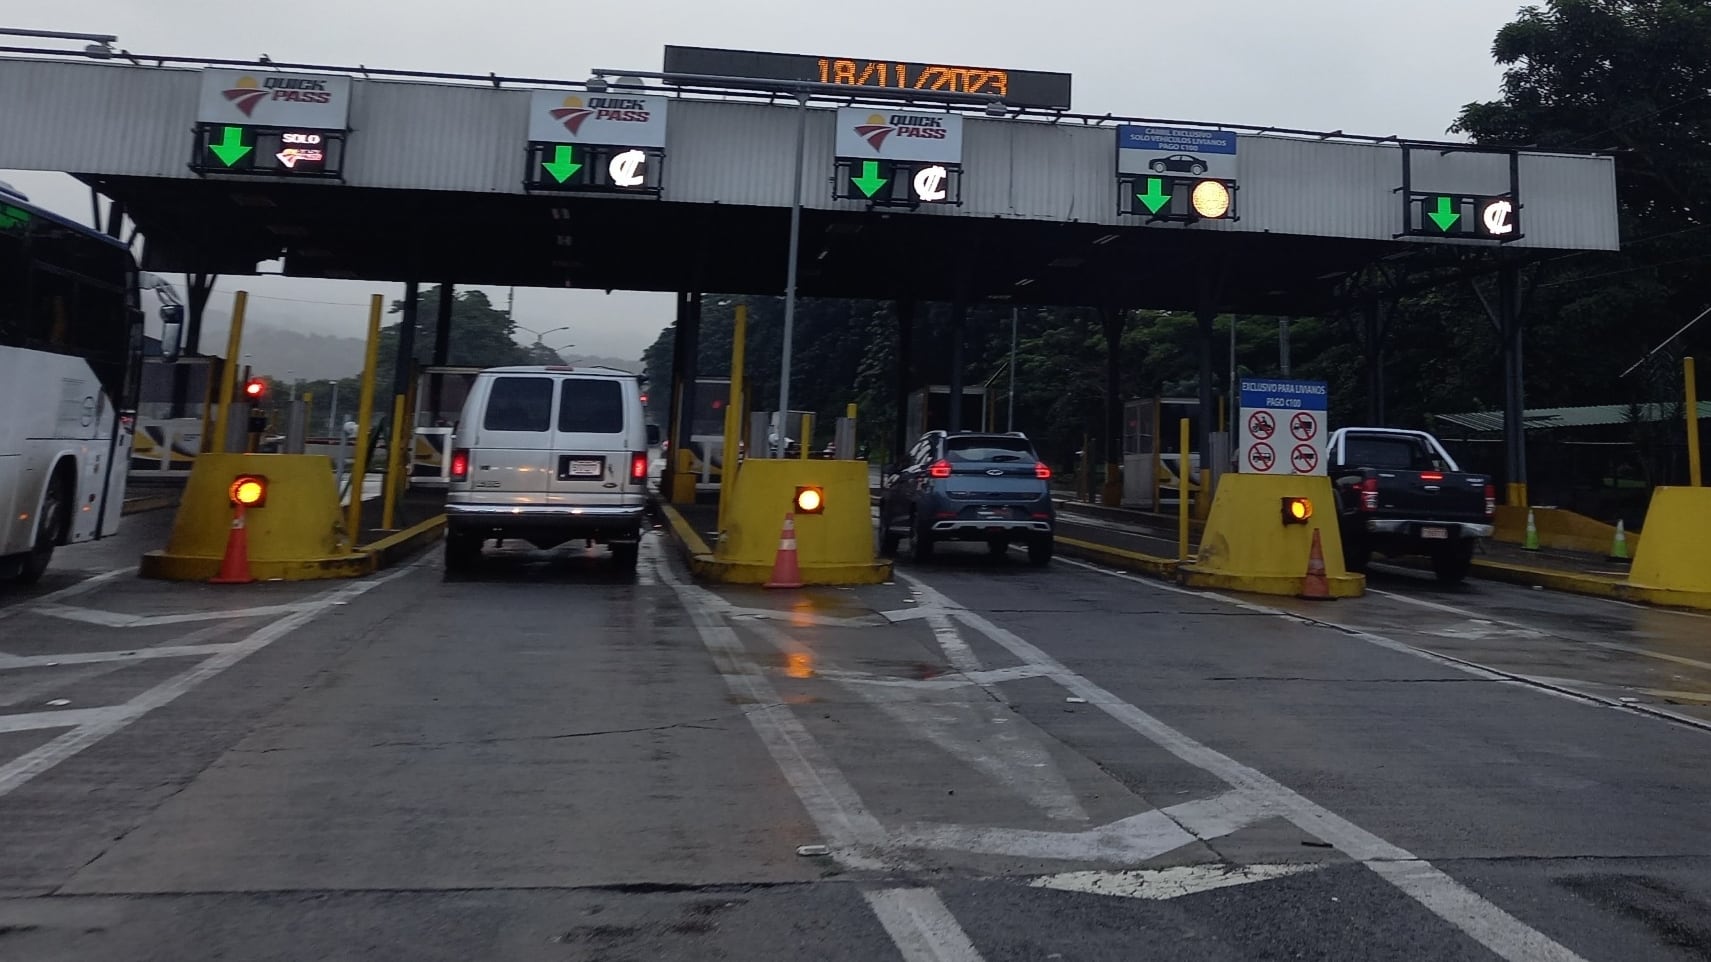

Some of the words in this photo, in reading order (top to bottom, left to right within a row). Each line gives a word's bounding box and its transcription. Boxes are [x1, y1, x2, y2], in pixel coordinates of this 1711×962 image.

[263, 77, 327, 91] QUICK
[818, 58, 1007, 97] 18/11/2023
[272, 90, 331, 104] PASS
[588, 97, 646, 110] QUICK
[595, 109, 650, 122] PASS
[889, 114, 943, 127] QUICK
[282, 133, 321, 144] SOLO
[896, 126, 947, 139] PASS
[1173, 129, 1213, 139] EXCLUSIVO
[1130, 133, 1150, 141] SOLO
[1192, 138, 1227, 147] LIVIANOS
[1158, 142, 1180, 150] PAGO
[1242, 382, 1278, 393] EXCLUSIVO
[1278, 383, 1295, 393] PARA
[1295, 385, 1326, 395] LIVIANOS
[1266, 397, 1285, 407] PAGO
